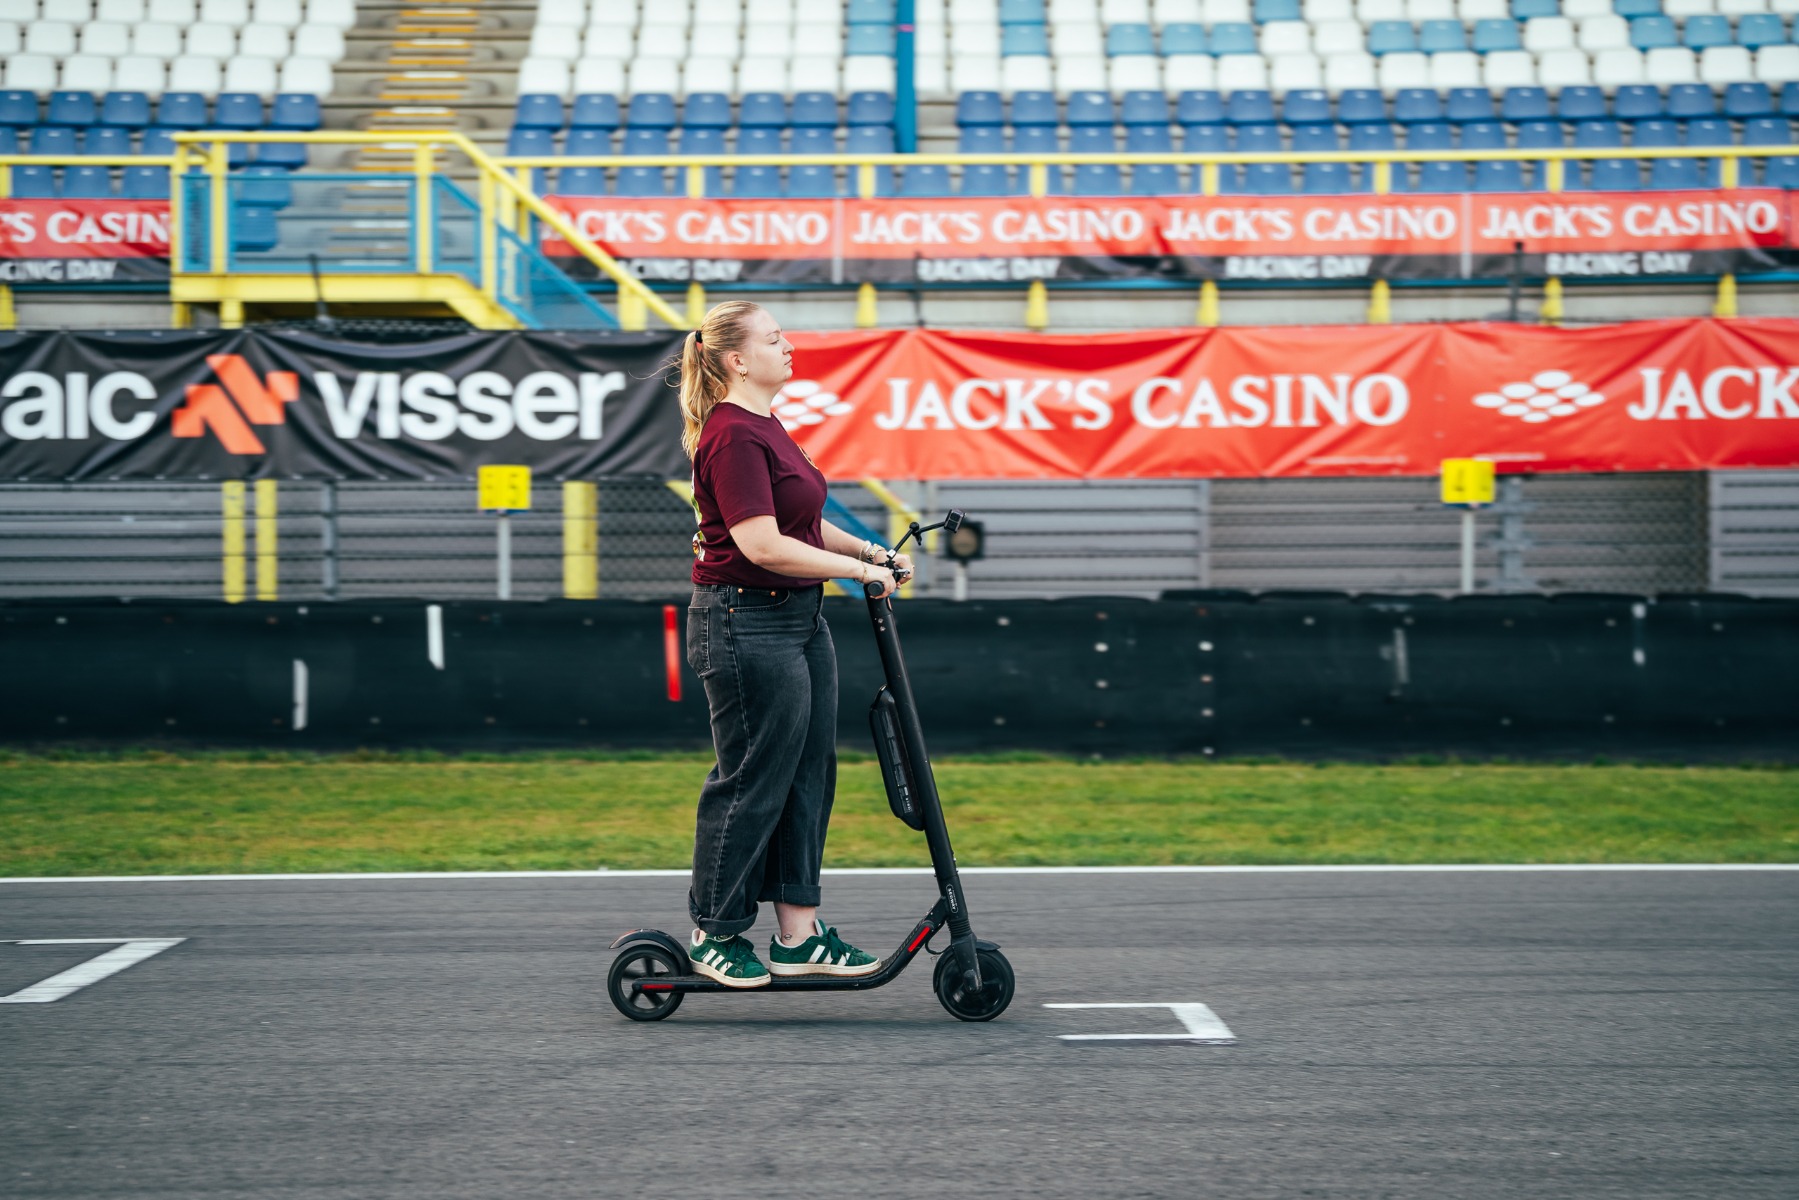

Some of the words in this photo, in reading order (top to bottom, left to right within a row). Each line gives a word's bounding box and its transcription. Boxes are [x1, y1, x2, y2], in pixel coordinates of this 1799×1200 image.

[46, 211, 170, 243] CASIN
[676, 211, 829, 244] CASINO
[852, 211, 982, 244] JACK'S
[991, 209, 1144, 243] CASINO
[1164, 208, 1294, 241] JACK'S
[1303, 207, 1456, 240] CASINO
[1481, 205, 1613, 238] JACK'S
[1622, 201, 1779, 236] CASINO
[313, 371, 626, 440] visser
[874, 377, 1113, 430] JACK'S
[1131, 373, 1409, 429] CASINO
[1626, 366, 1799, 420] JACK
